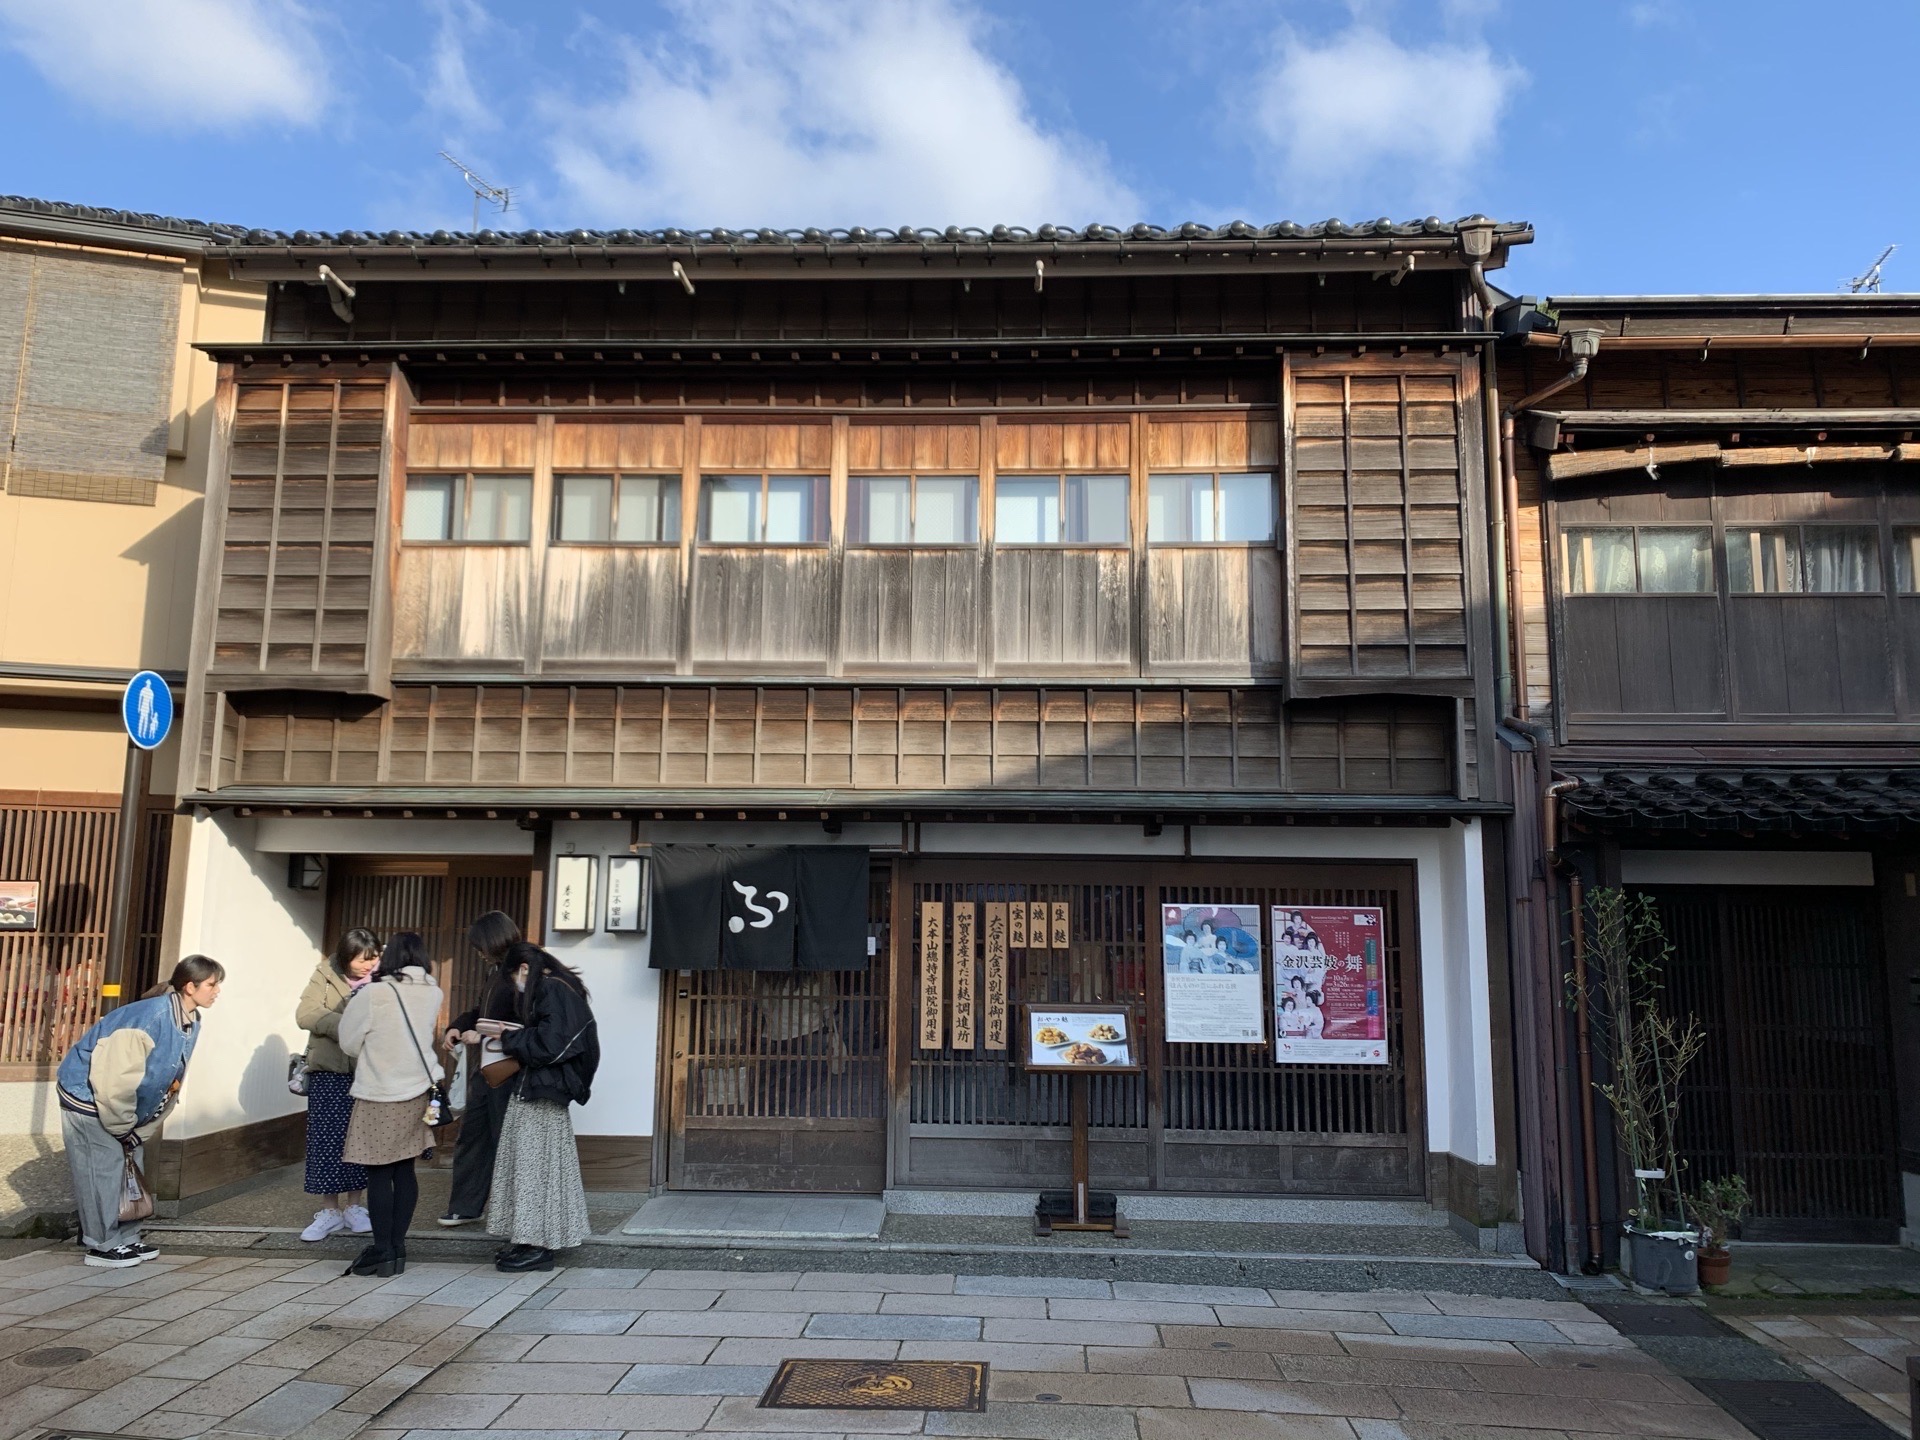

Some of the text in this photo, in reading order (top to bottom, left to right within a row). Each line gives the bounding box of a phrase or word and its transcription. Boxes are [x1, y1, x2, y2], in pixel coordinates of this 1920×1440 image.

[610, 895, 622, 927] 不室屋
[728, 880, 790, 934] ふ
[1011, 907, 1025, 943] 宝の麩
[956, 913, 972, 1043] 加賀名産すだれ麩調進所
[988, 916, 1004, 1045] 大谷派金沢別院御用達
[1281, 953, 1363, 974] 金沢芸妓の舞
[1037, 1015, 1069, 1023] おやつ麩
